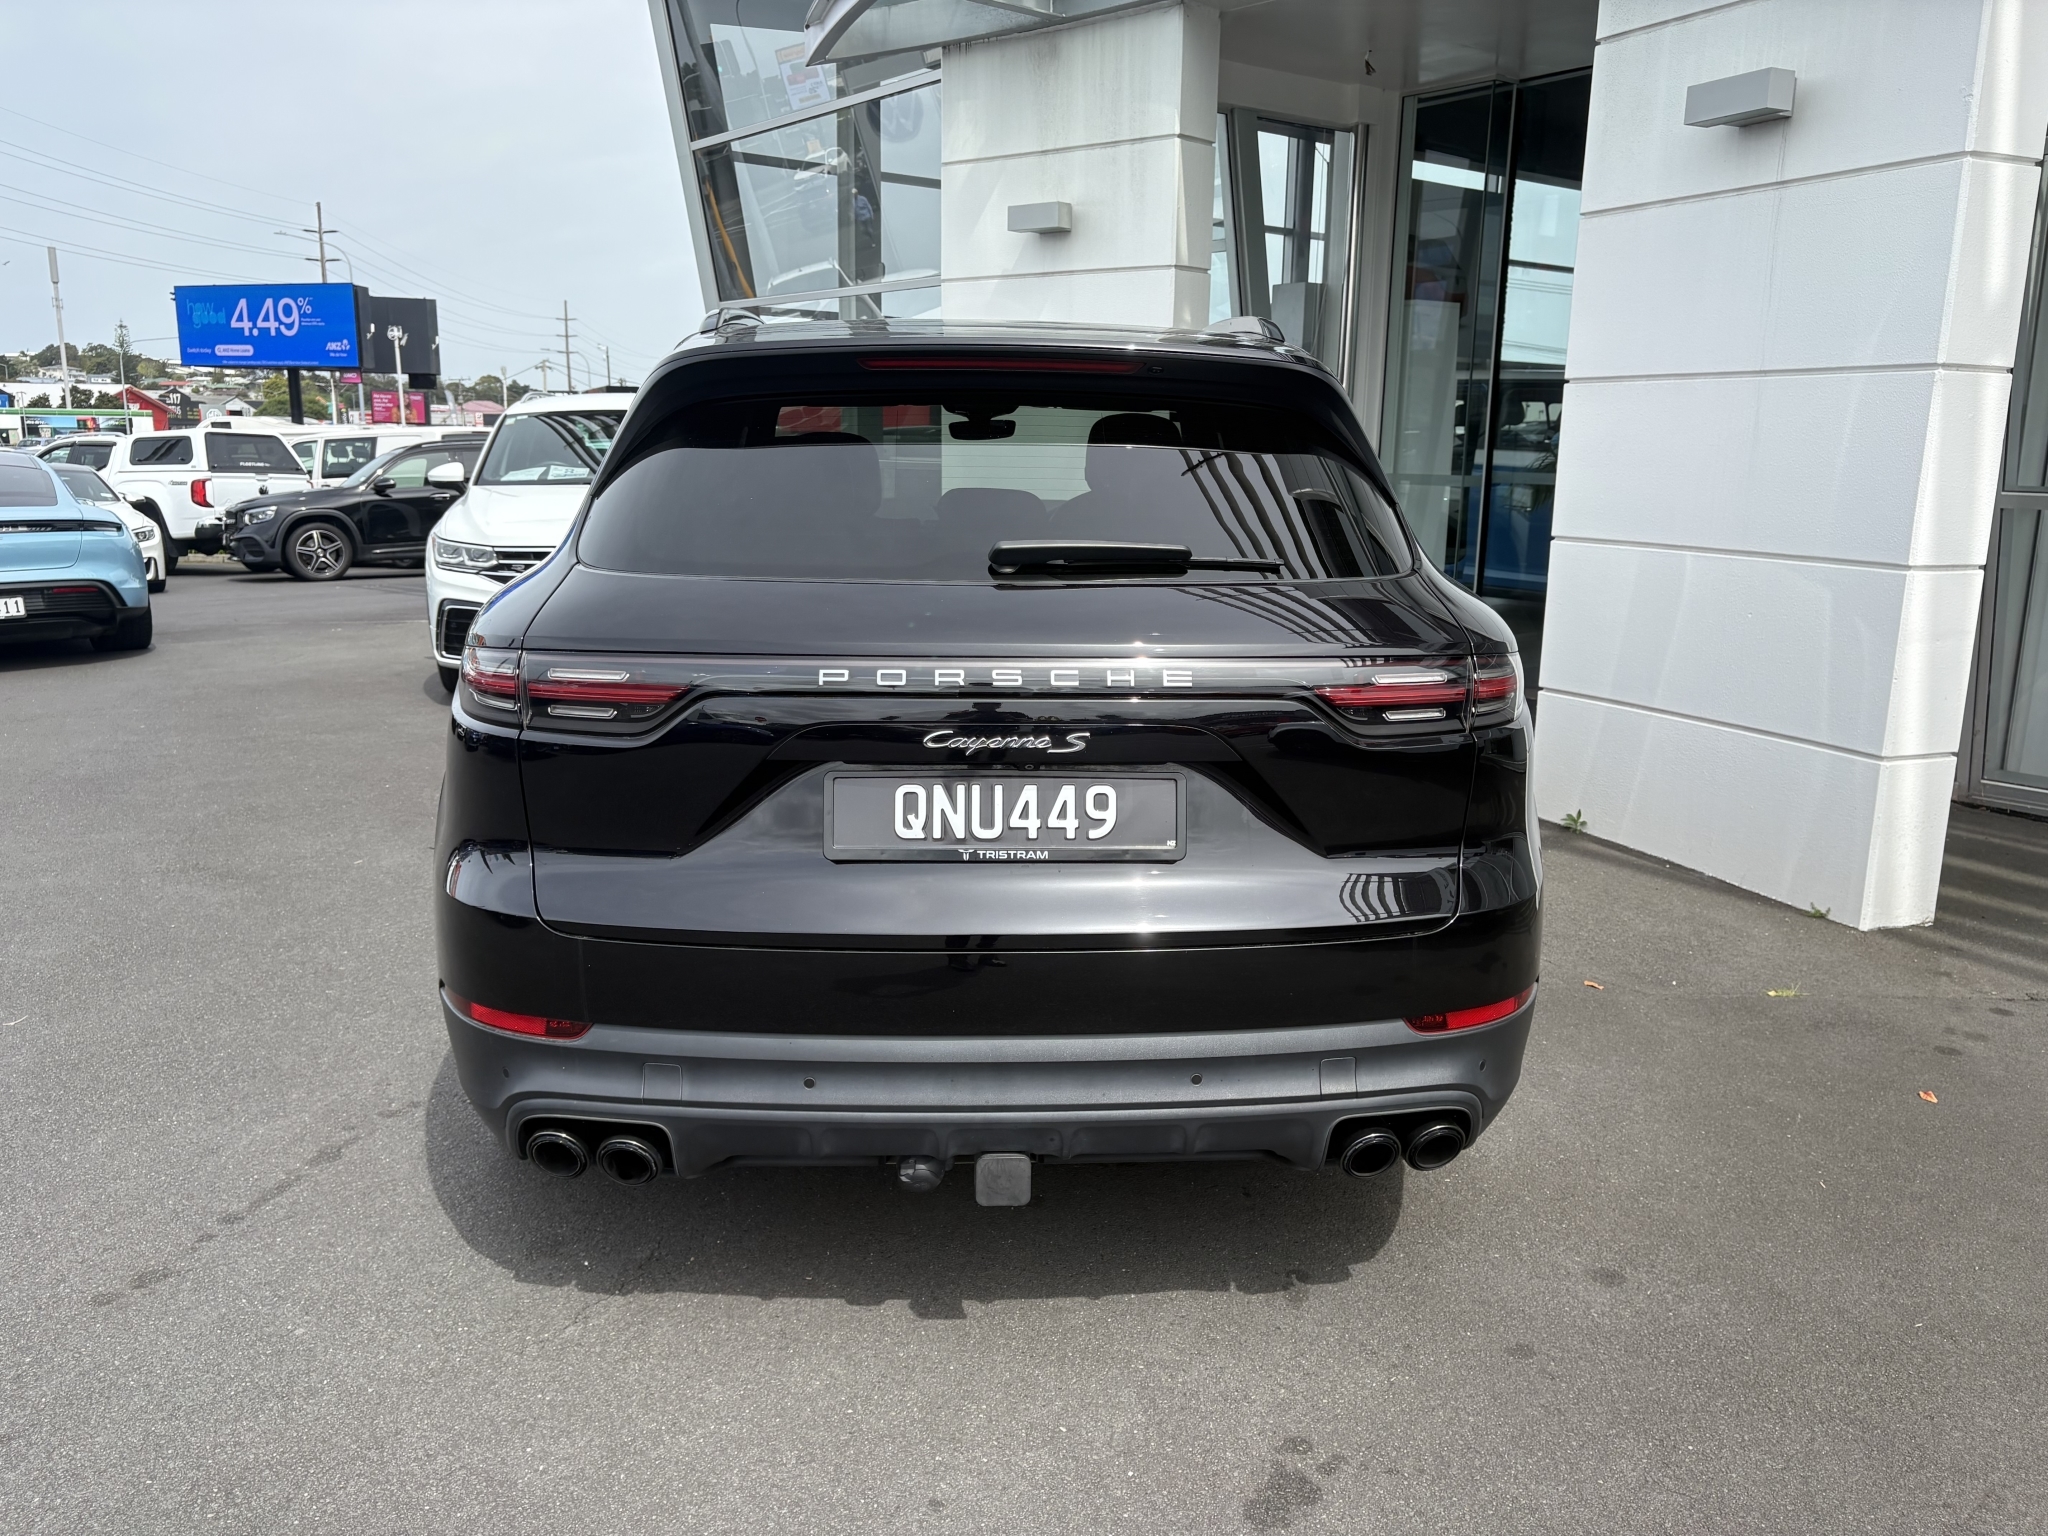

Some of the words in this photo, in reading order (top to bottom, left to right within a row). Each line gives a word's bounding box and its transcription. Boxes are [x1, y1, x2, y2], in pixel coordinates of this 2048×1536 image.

[325, 341, 342, 351] ANZ
[0, 599, 21, 615] 11
[818, 669, 1193, 688] PORSCHE
[923, 730, 1052, 756] Cayenne
[1047, 732, 1091, 754] S
[894, 783, 1117, 840] QNU449
[976, 850, 1049, 860] TRISTRAM
